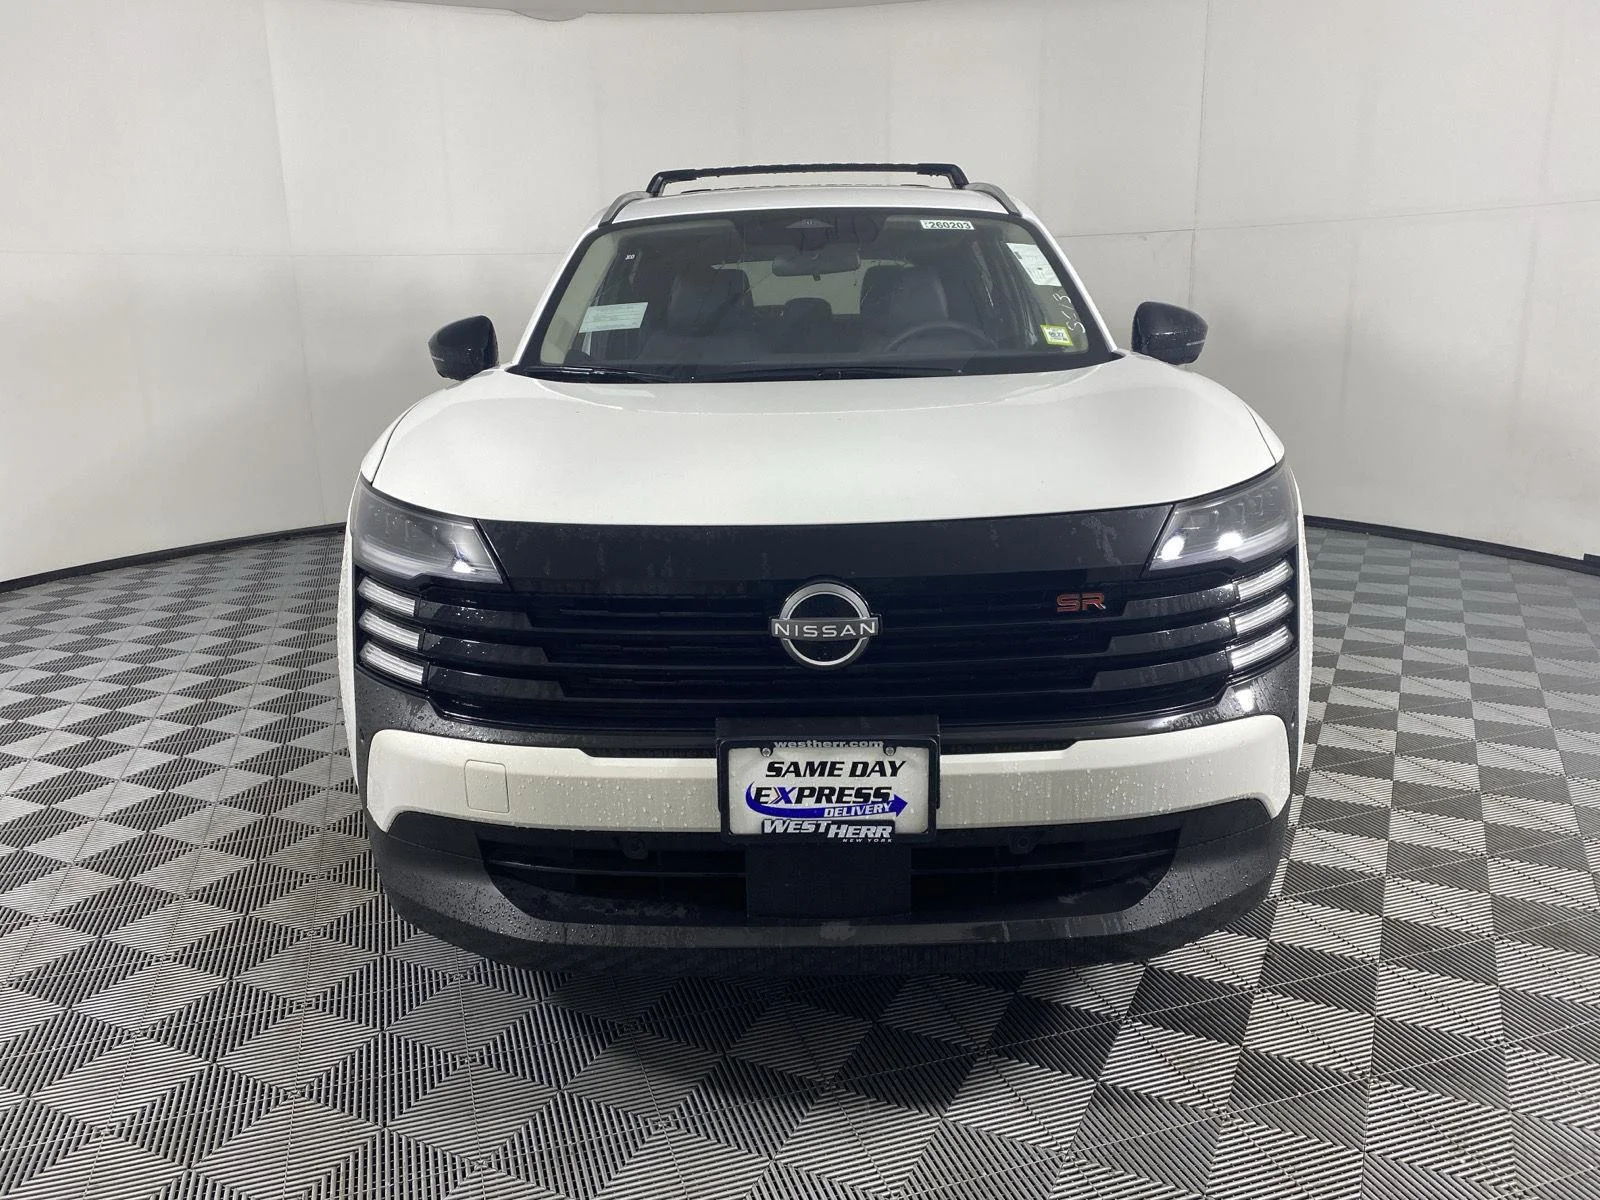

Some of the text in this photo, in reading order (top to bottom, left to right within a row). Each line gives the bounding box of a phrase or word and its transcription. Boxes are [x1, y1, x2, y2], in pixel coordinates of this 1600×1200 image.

[929, 221, 971, 229] 260203
[1056, 593, 1106, 612] SR
[774, 621, 876, 638] NISSAN
[773, 740, 884, 749] westherr.com
[765, 761, 906, 778] SAME DAY
[754, 786, 893, 804] EXPRESS
[823, 801, 893, 818] DELIVERY
